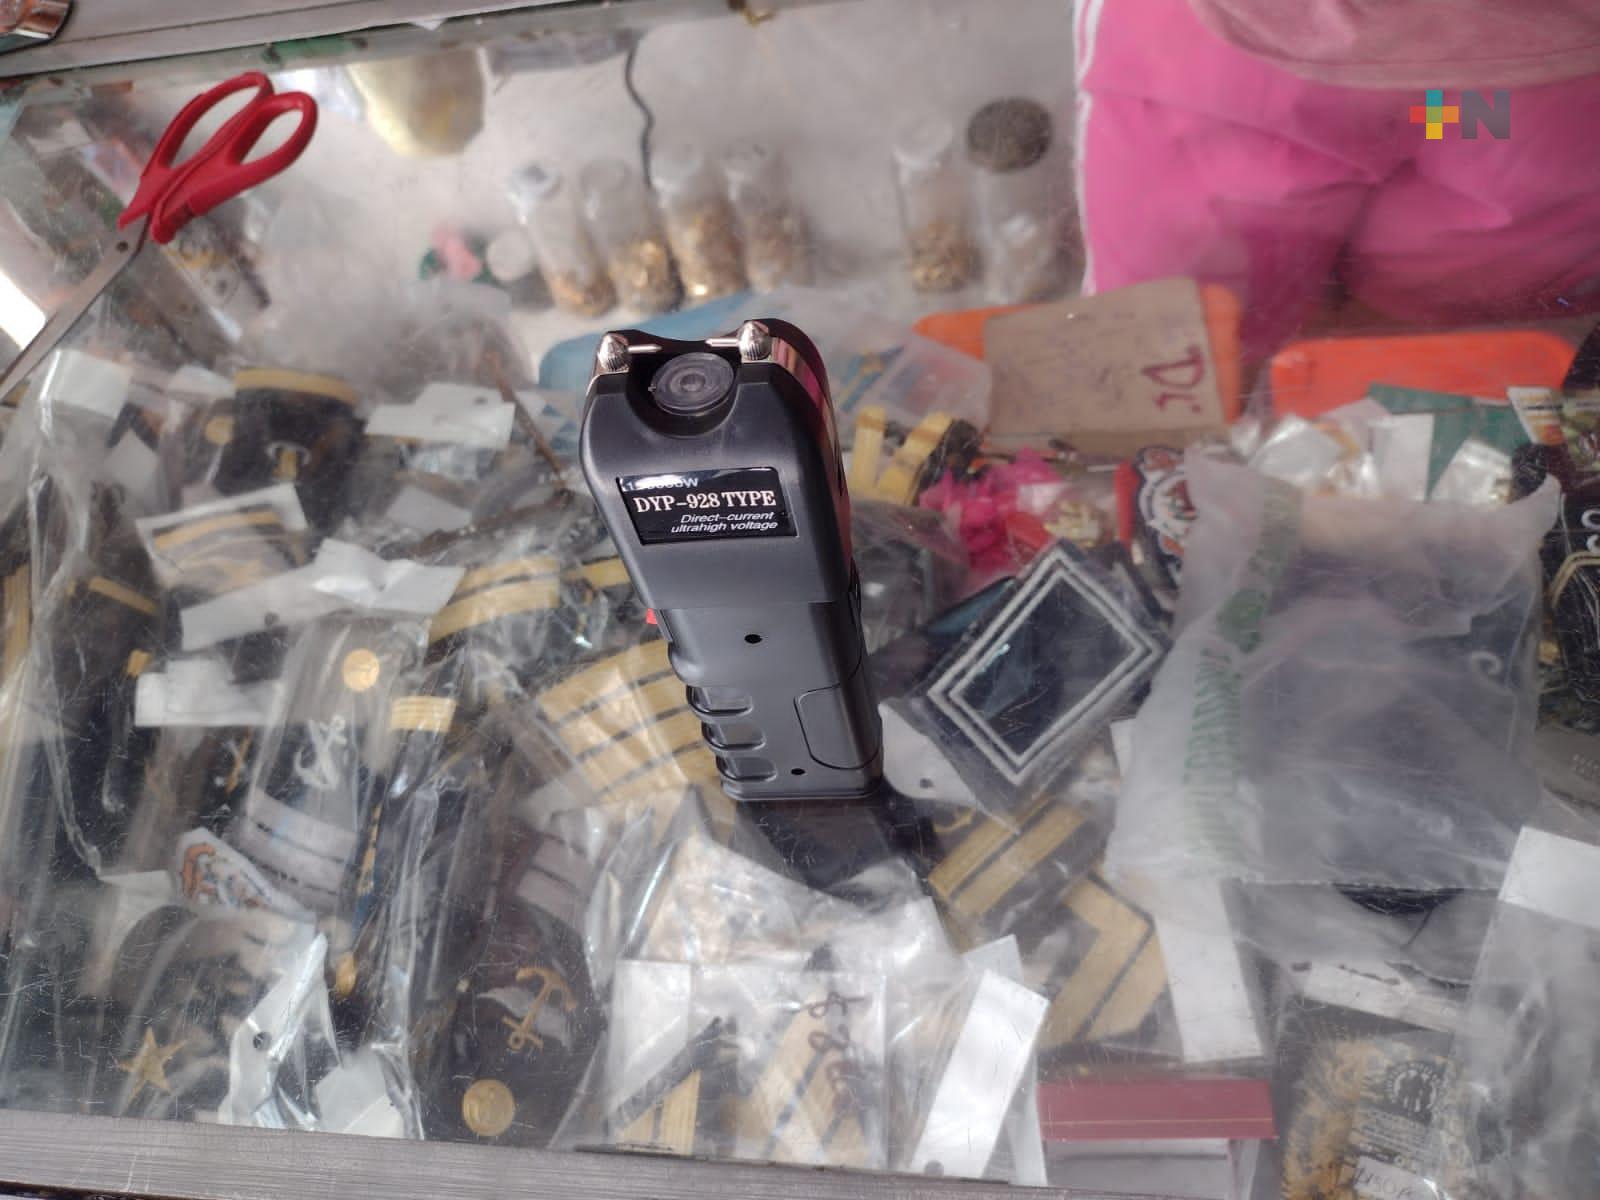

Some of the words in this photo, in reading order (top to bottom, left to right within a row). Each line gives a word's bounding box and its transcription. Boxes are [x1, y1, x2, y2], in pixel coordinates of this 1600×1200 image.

[633, 492, 721, 512] DYP-928
[722, 490, 777, 507] TYPE
[681, 511, 774, 524] Direct-current
[671, 522, 727, 534] ultrahigh
[730, 520, 779, 532] voltage
